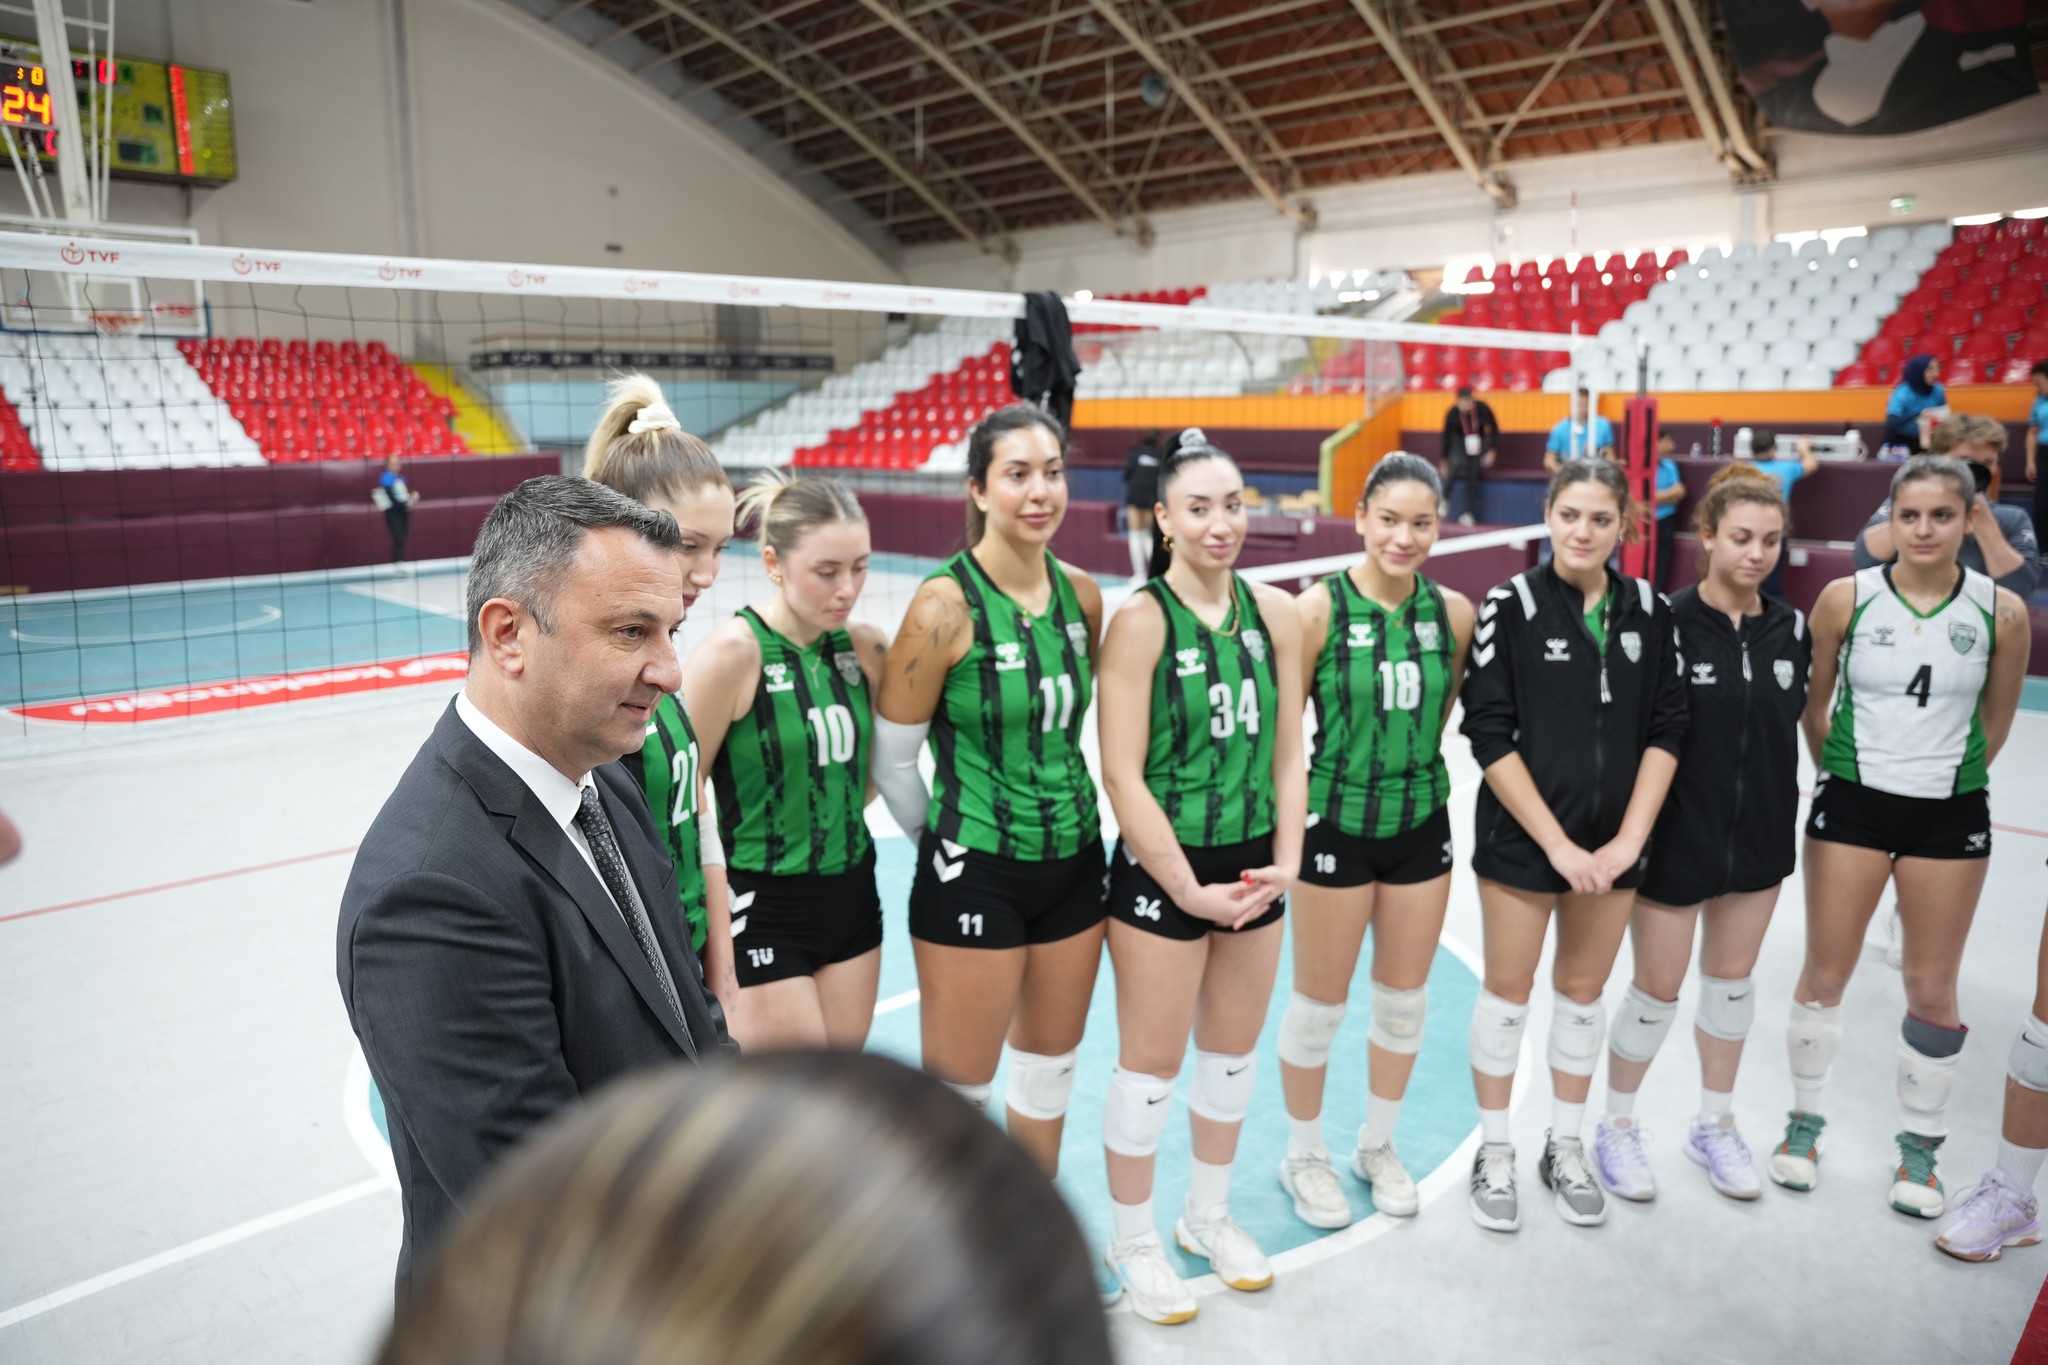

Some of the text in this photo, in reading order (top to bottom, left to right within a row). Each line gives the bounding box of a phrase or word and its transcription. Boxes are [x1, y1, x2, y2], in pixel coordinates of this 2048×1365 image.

[2, 85, 50, 125] 24
[88, 251, 119, 264] TVF
[254, 261, 281, 272] TVF
[399, 268, 422, 279] TVF
[1039, 674, 1075, 733] 11
[1378, 661, 1421, 711] 18
[1905, 665, 1932, 707] 4
[1208, 678, 1261, 739] 34
[807, 705, 855, 767] 10
[672, 742, 698, 827] 21
[1314, 853, 1336, 874] 18
[957, 913, 984, 937] 11
[1133, 895, 1162, 922] 34
